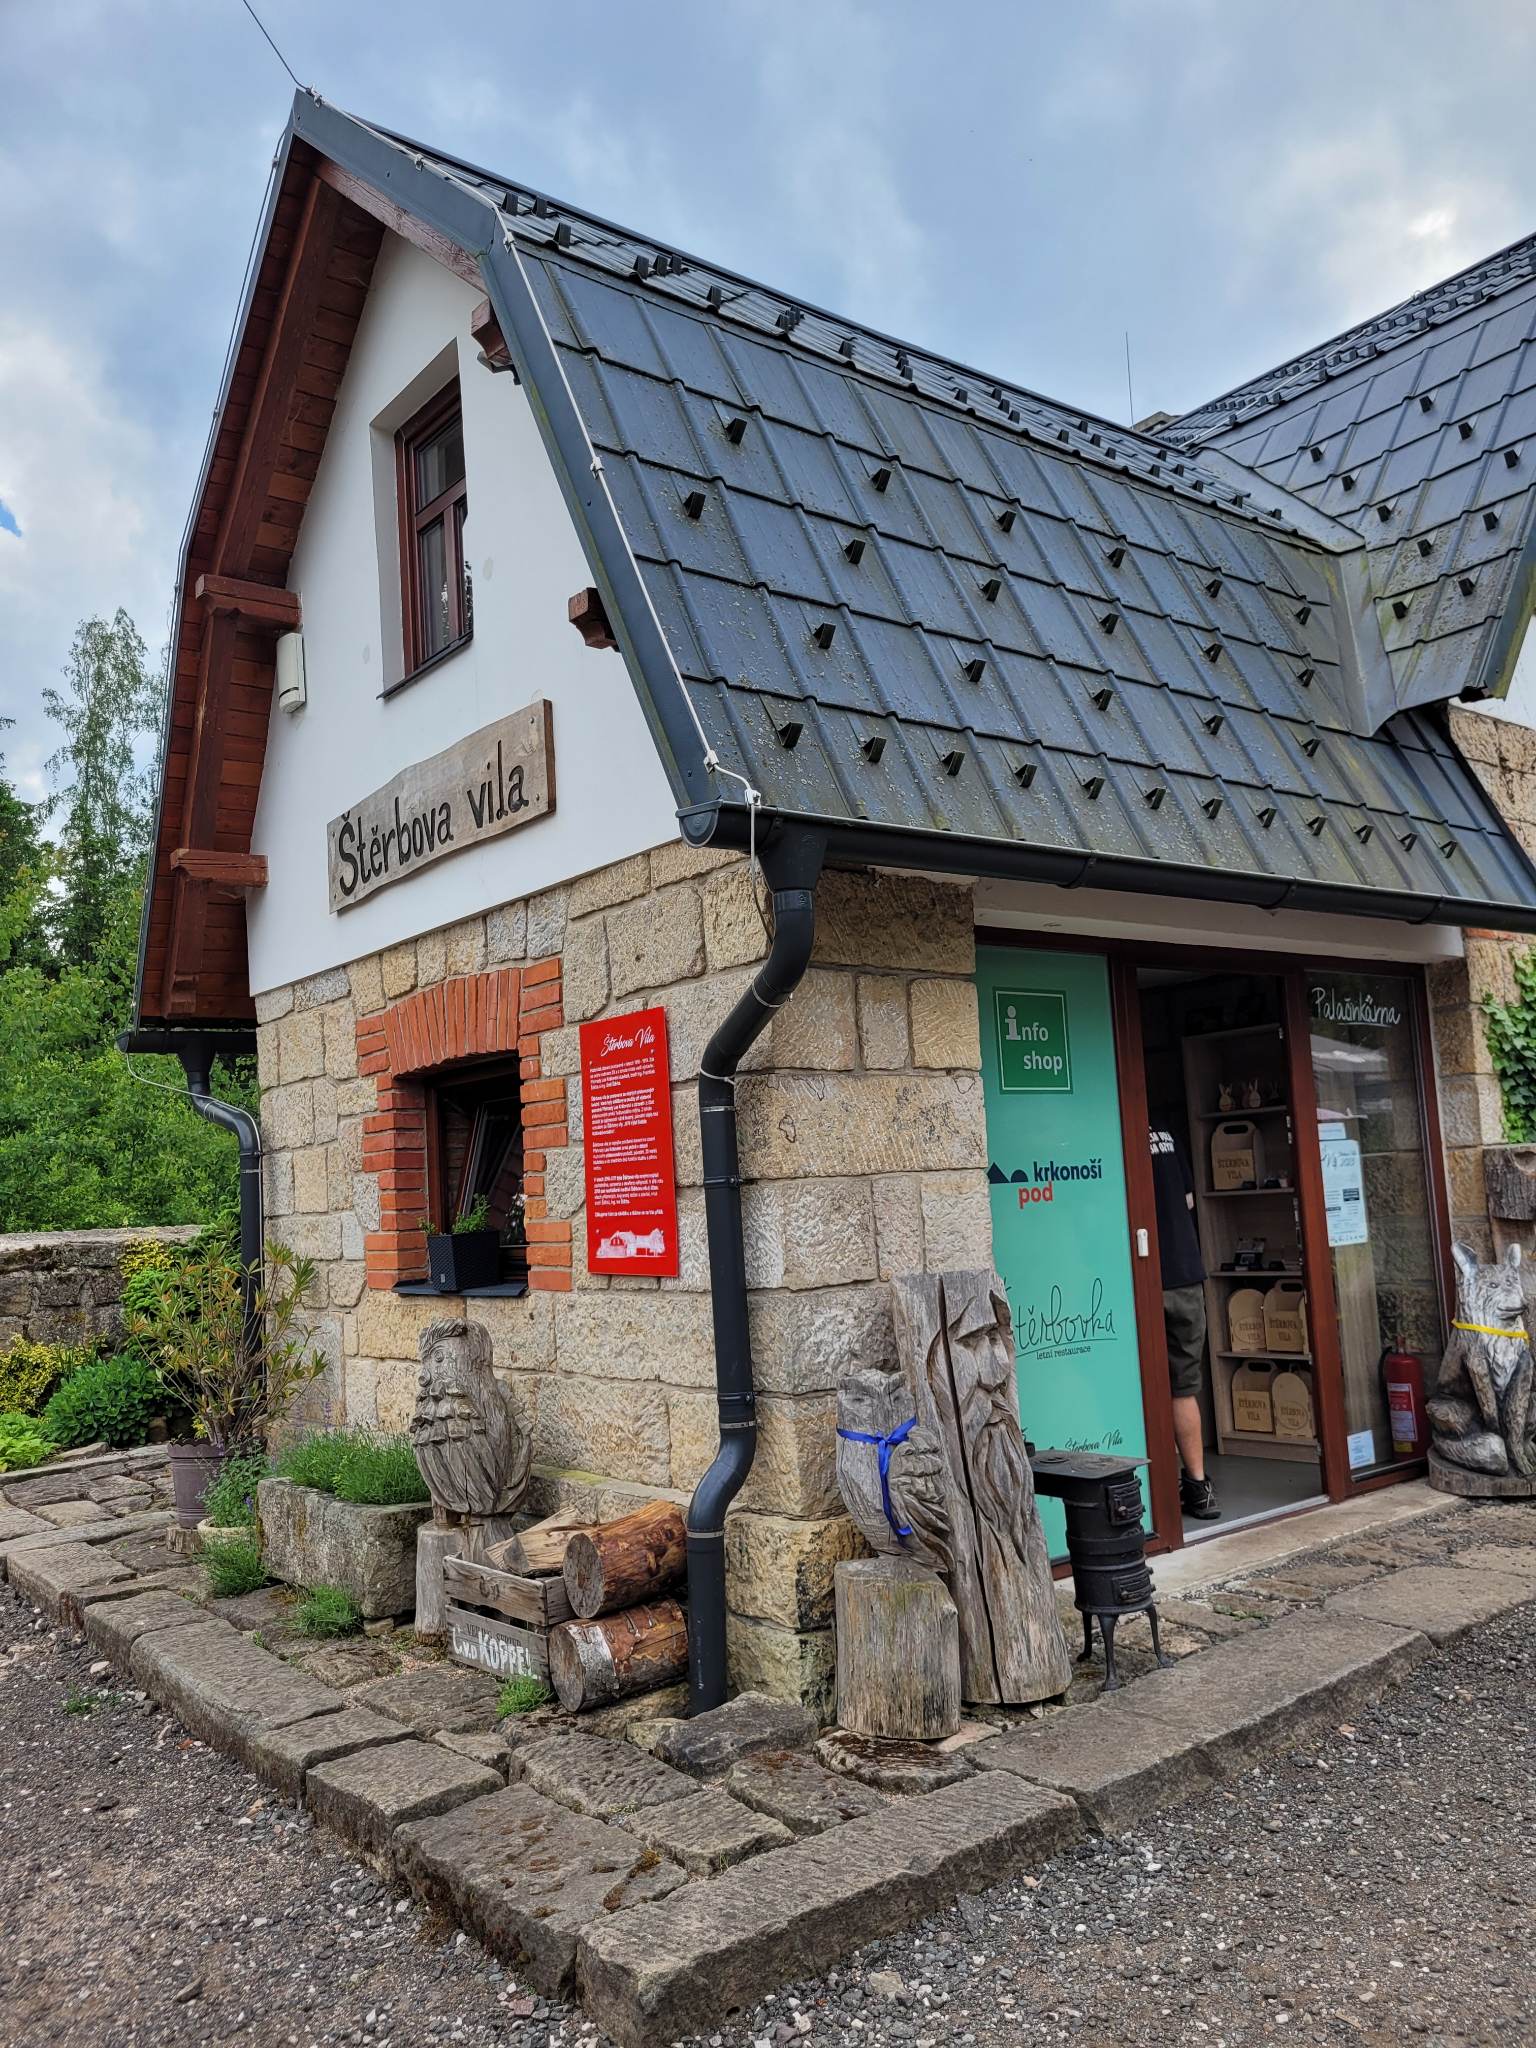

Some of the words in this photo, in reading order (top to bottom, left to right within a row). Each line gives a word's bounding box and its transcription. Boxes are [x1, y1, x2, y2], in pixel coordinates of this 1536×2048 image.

[339, 796, 454, 896] Štěrbova
[467, 740, 529, 829] vila
[1005, 1005, 1049, 1042] info
[635, 1026, 656, 1049] Vila
[1023, 1050, 1063, 1075] shop
[1033, 1158, 1102, 1183] krkonoší
[1018, 1181, 1053, 1209] pod
[1004, 1277, 1116, 1349] těrbovka
[1036, 1350, 1054, 1360] letní
[1054, 1345, 1092, 1358] restaurace
[1102, 1429, 1124, 1450] Vila
